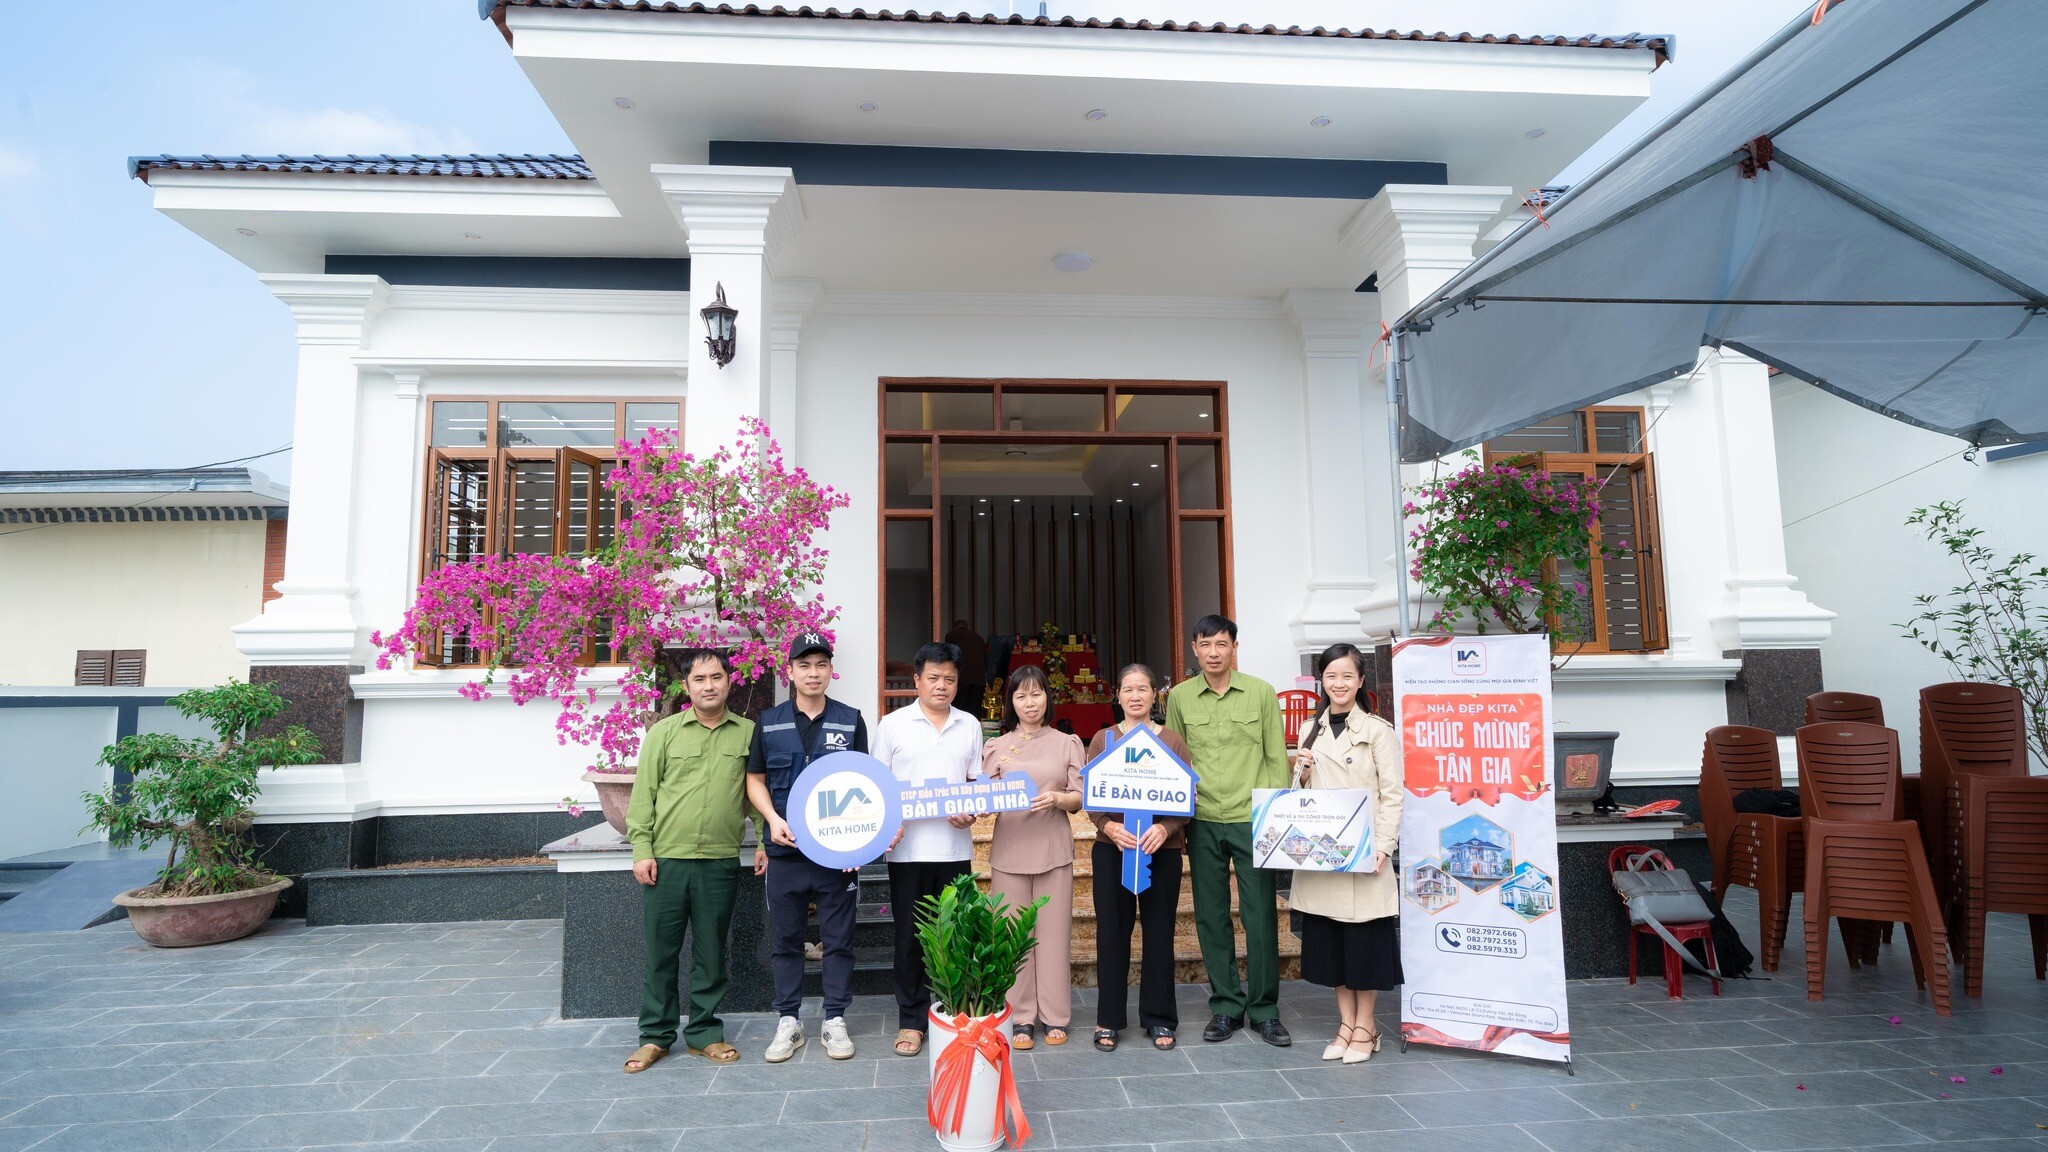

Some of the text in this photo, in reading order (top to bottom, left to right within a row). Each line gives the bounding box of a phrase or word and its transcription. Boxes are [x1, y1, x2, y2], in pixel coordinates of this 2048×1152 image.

[804, 632, 820, 644] NY
[1427, 702, 1517, 715] NHÀ ĐẸP KITA
[1414, 718, 1530, 749] CHÚC MỪNG
[1435, 753, 1512, 784] TÂN GIA
[901, 790, 916, 800] CTCP
[991, 782, 1006, 792] KITA
[1007, 780, 1026, 790] HOME
[1092, 780, 1186, 803] LỄ BÀN GIAO
[902, 790, 1029, 819] BÀN GIAO NHÀ
[818, 822, 877, 837] KITA HOME
[1466, 927, 1517, 937] 082.7972.666
[1466, 936, 1517, 946] 082.7972.555
[1467, 944, 1518, 954] 082.5979.333
